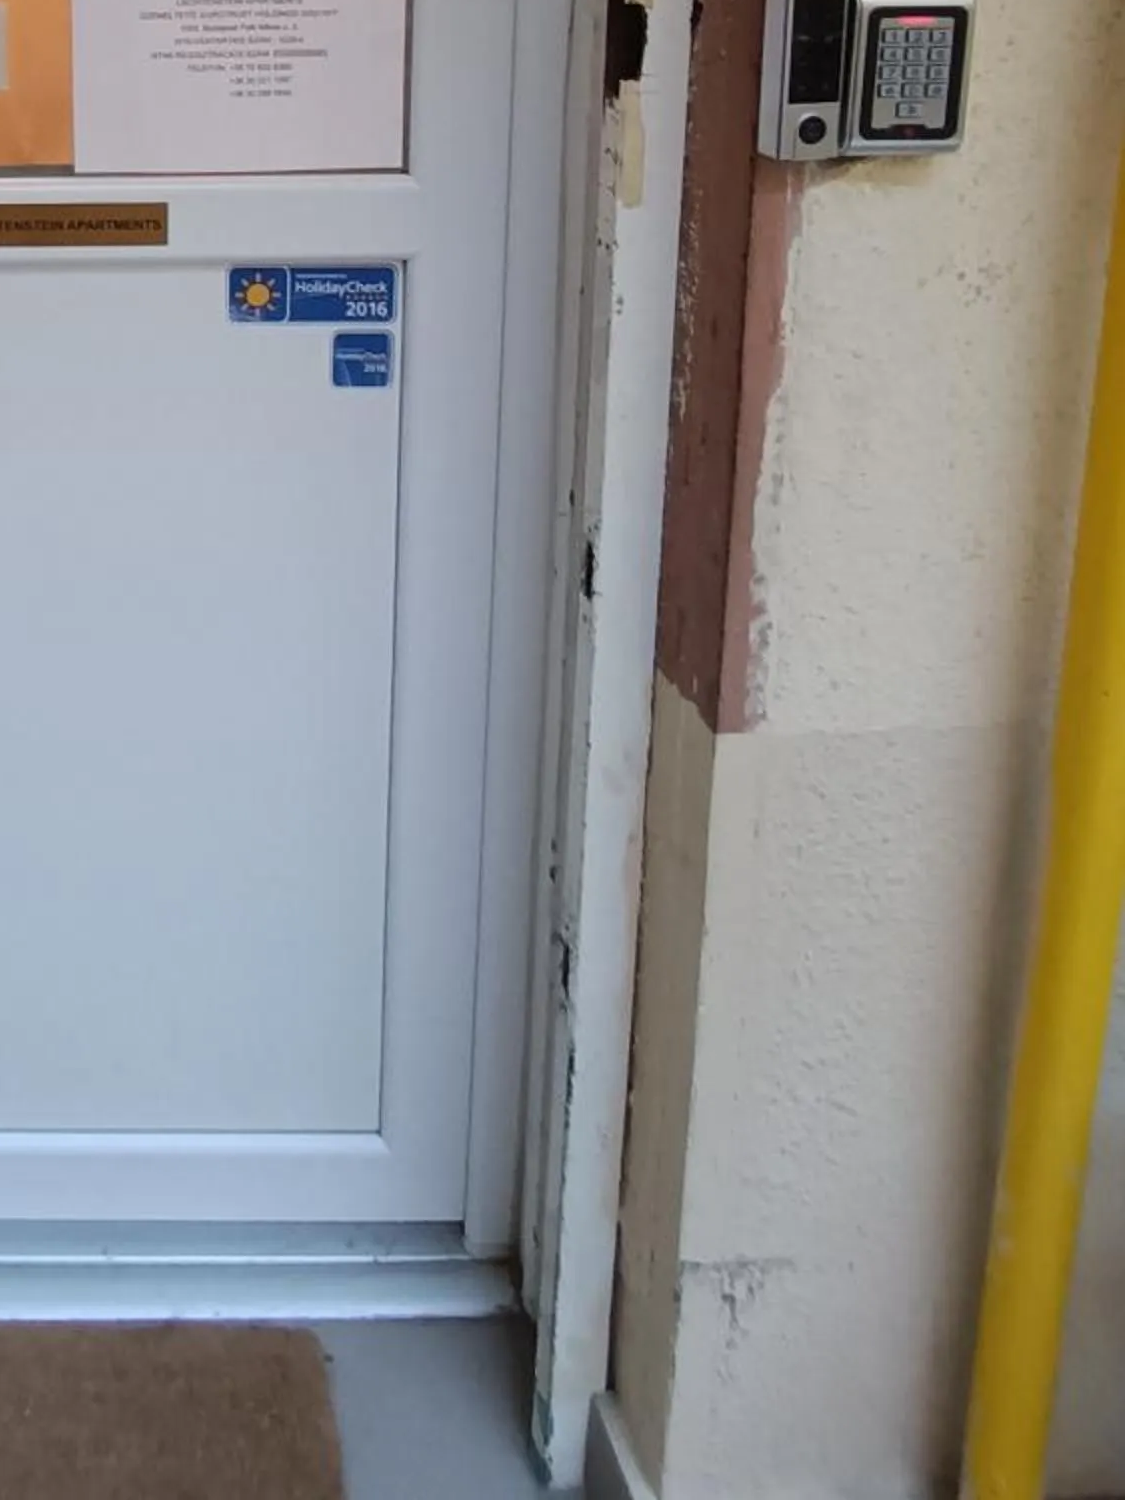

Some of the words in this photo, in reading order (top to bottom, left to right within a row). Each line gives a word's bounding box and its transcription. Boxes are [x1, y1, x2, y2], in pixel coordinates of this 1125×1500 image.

[67, 219, 162, 232] APARTMENTS
[295, 281, 388, 298] HolidayCheck
[345, 302, 388, 317] 2016
